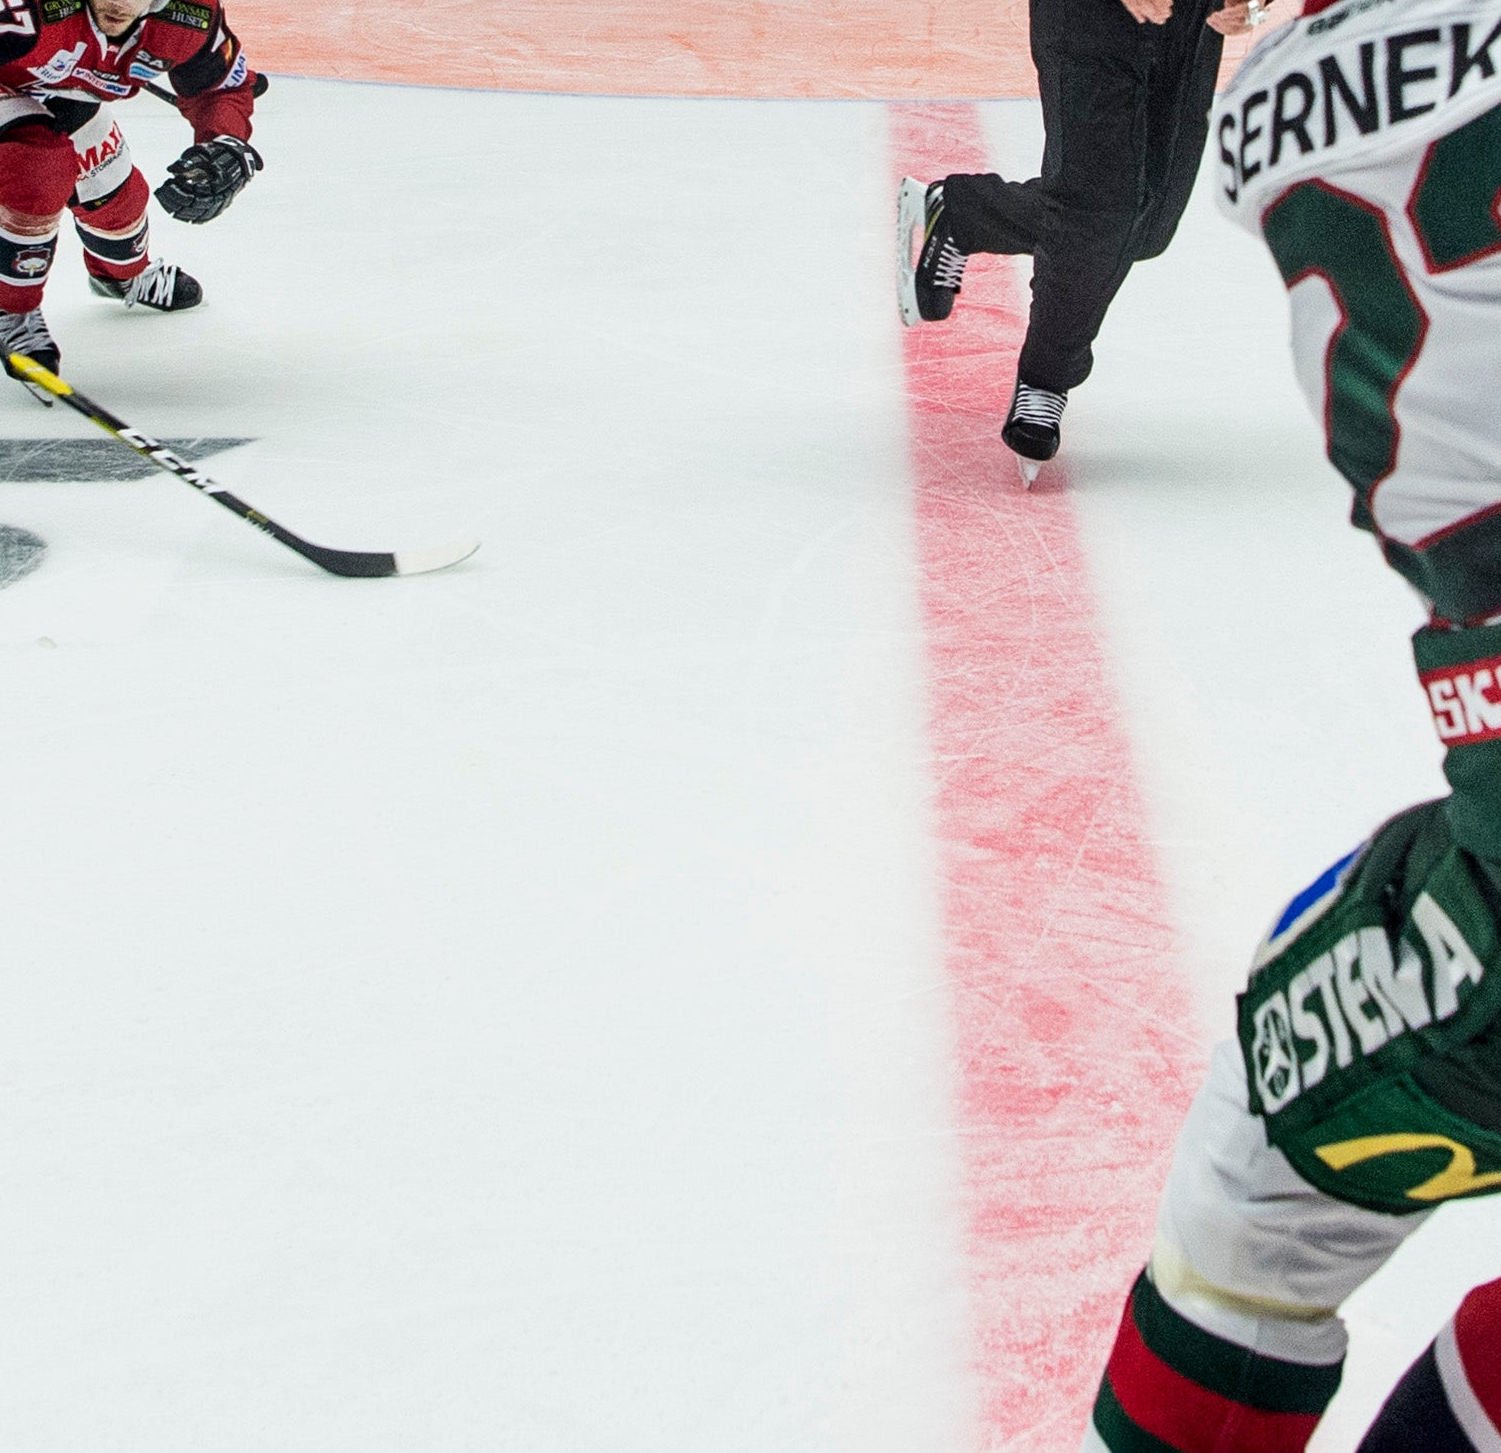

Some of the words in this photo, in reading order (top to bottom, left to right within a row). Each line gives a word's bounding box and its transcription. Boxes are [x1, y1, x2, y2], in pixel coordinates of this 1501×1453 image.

[135, 48, 164, 69] SA
[117, 427, 228, 495] CCM
[1287, 891, 1484, 1092] STENA
